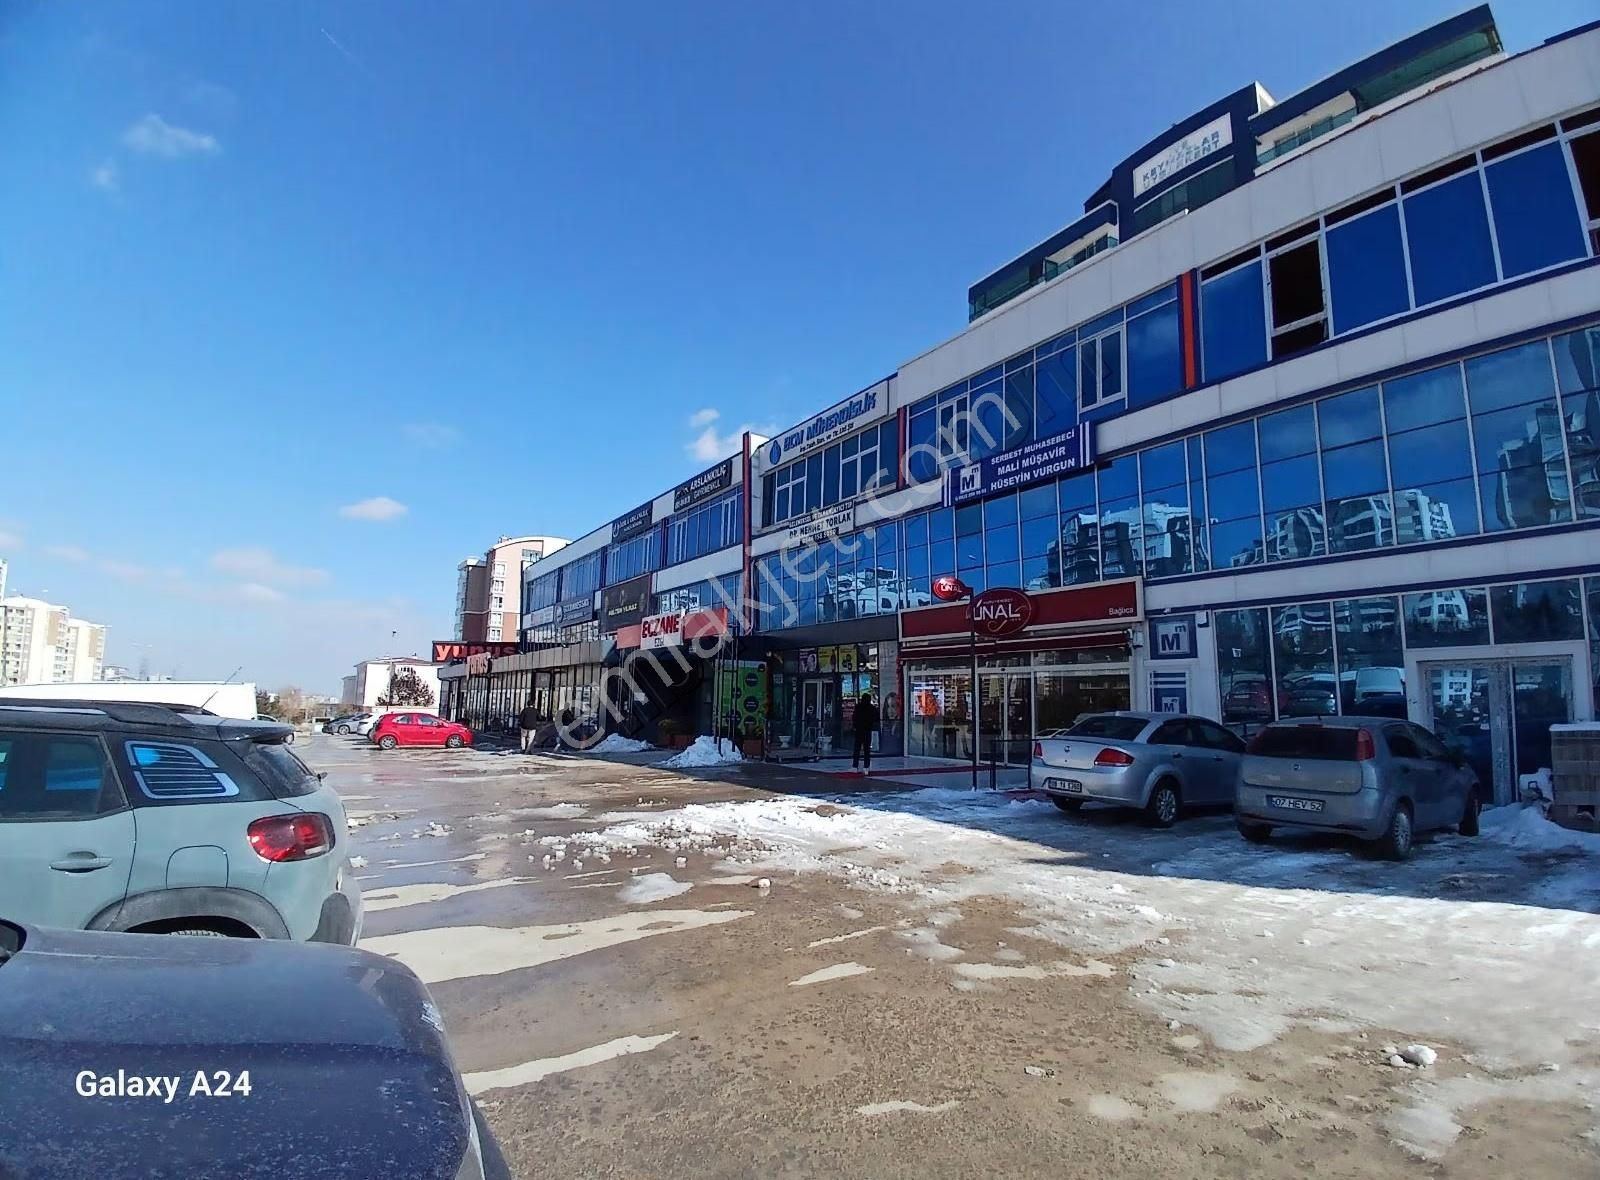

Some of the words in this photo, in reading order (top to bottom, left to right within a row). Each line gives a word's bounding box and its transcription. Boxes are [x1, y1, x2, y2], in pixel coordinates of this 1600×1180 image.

[991, 449, 1022, 465] SERBEST
[1024, 428, 1075, 453] MUHASEBECİ
[997, 461, 1020, 476] MALİ
[1021, 446, 1066, 466] MÜŞAVİR
[990, 472, 1031, 491] HÜSEYİN
[1033, 458, 1075, 478] VURGUN
[826, 512, 851, 528] TORLAK
[642, 614, 680, 638] ECZANE
[1161, 633, 1181, 651] M
[1288, 800, 1307, 809] HEV
